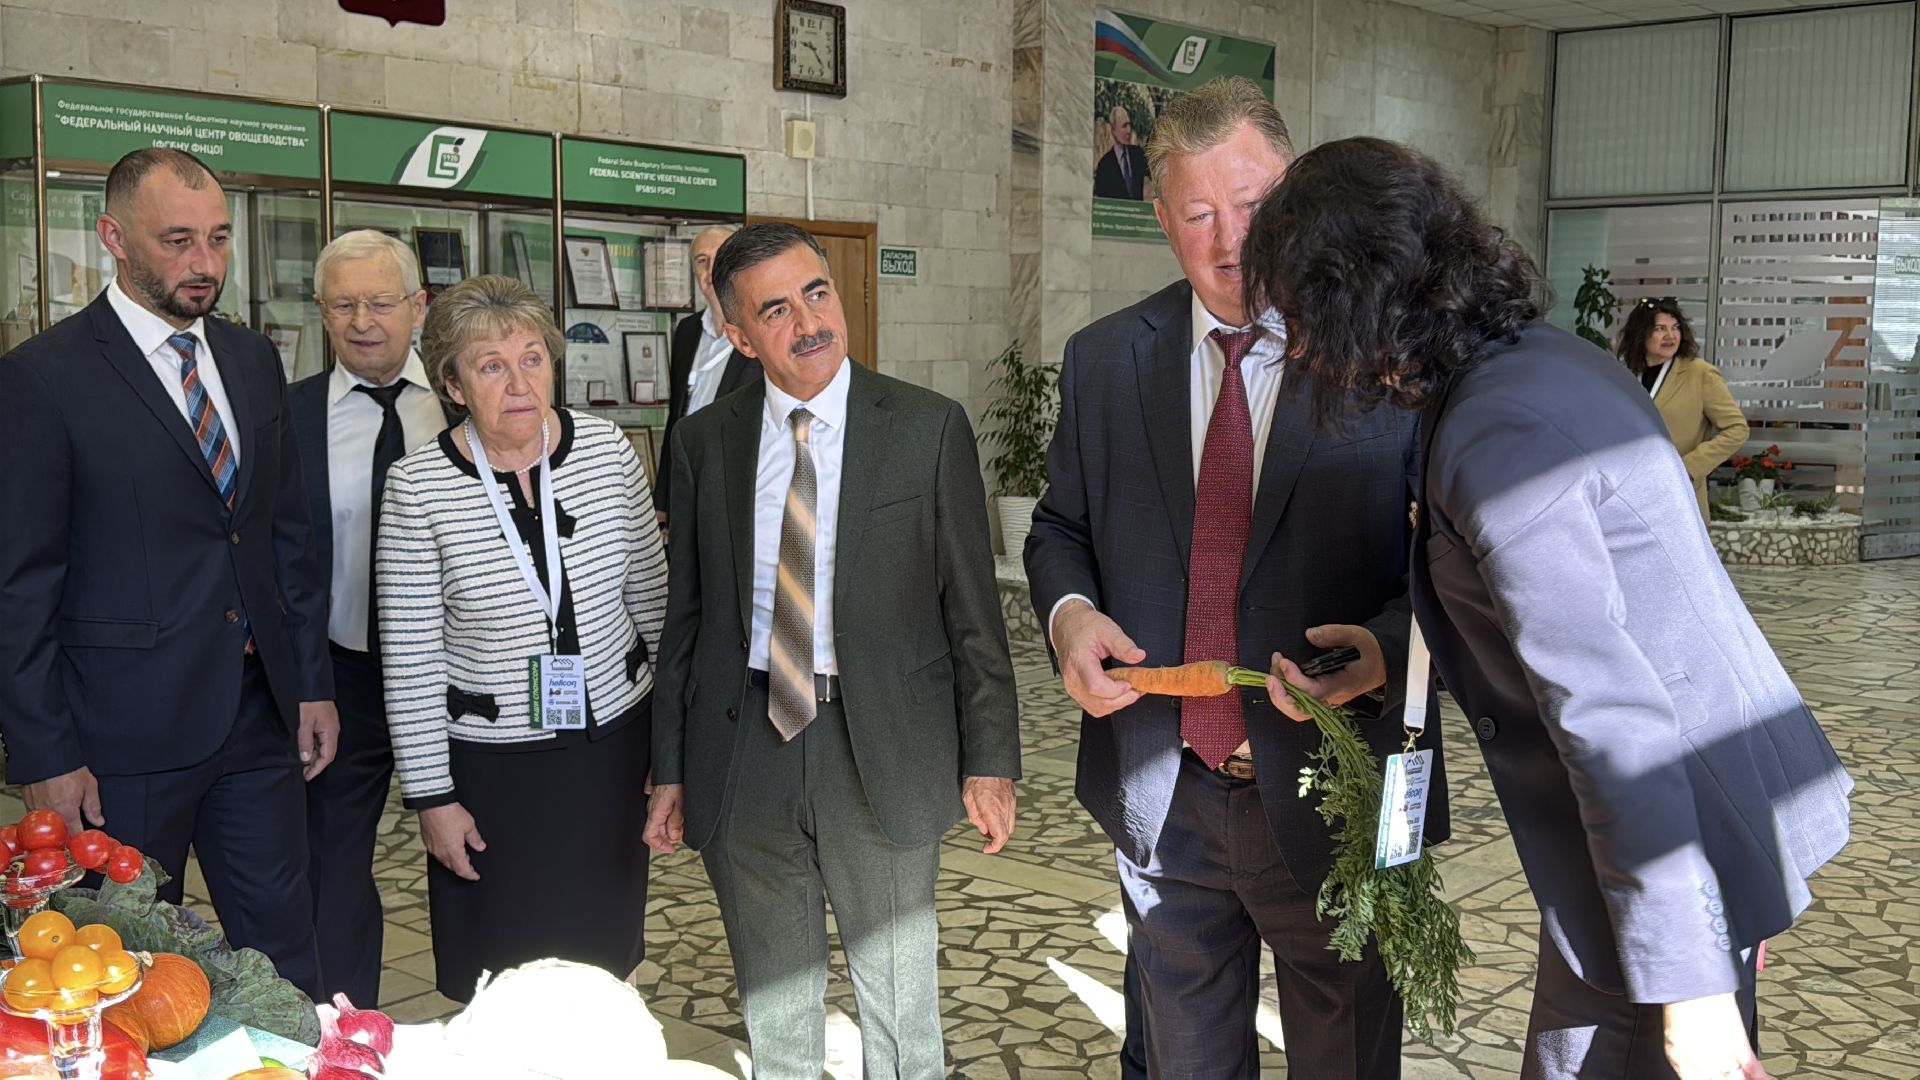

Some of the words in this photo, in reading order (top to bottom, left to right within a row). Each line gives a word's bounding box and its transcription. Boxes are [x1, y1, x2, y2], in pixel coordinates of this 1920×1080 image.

[58, 100, 114, 113] Федеральное
[116, 107, 183, 120] государственное
[185, 112, 228, 124] бюджетное
[229, 119, 260, 128] научное
[261, 122, 306, 132] учреждение
[143, 122, 193, 137] НАУЧНЫЙ
[194, 127, 226, 140] ЦЕНТР
[191, 143, 223, 155] ФНЦО)
[598, 156, 619, 165] Federal
[619, 158, 633, 166] State
[633, 159, 660, 170] Budgetary
[589, 167, 620, 179] FEDERAL
[620, 170, 657, 181] SCIENTIFIC
[656, 173, 692, 185] VEGETABLE
[692, 176, 718, 187] CENTER
[882, 259, 914, 274] ВЫХОД
[1896, 257, 1920, 272] ВЫХОД
[549, 679, 577, 688] helicon
